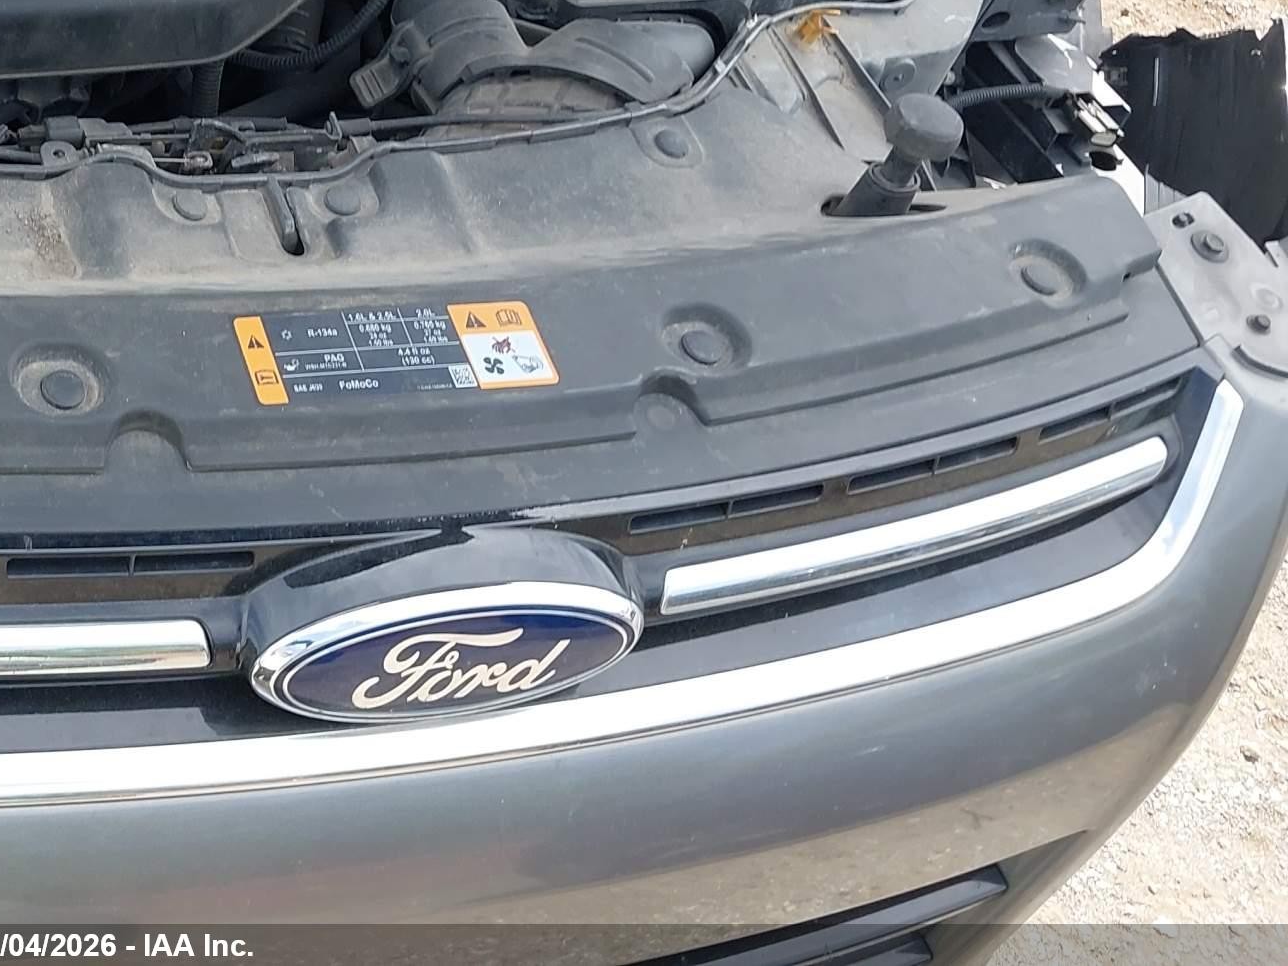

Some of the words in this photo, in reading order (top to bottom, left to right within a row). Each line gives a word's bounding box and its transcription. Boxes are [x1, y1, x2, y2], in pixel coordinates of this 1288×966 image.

[307, 328, 338, 338] R-134a
[339, 379, 379, 390] FoMoCo
[351, 628, 571, 710] Ford
